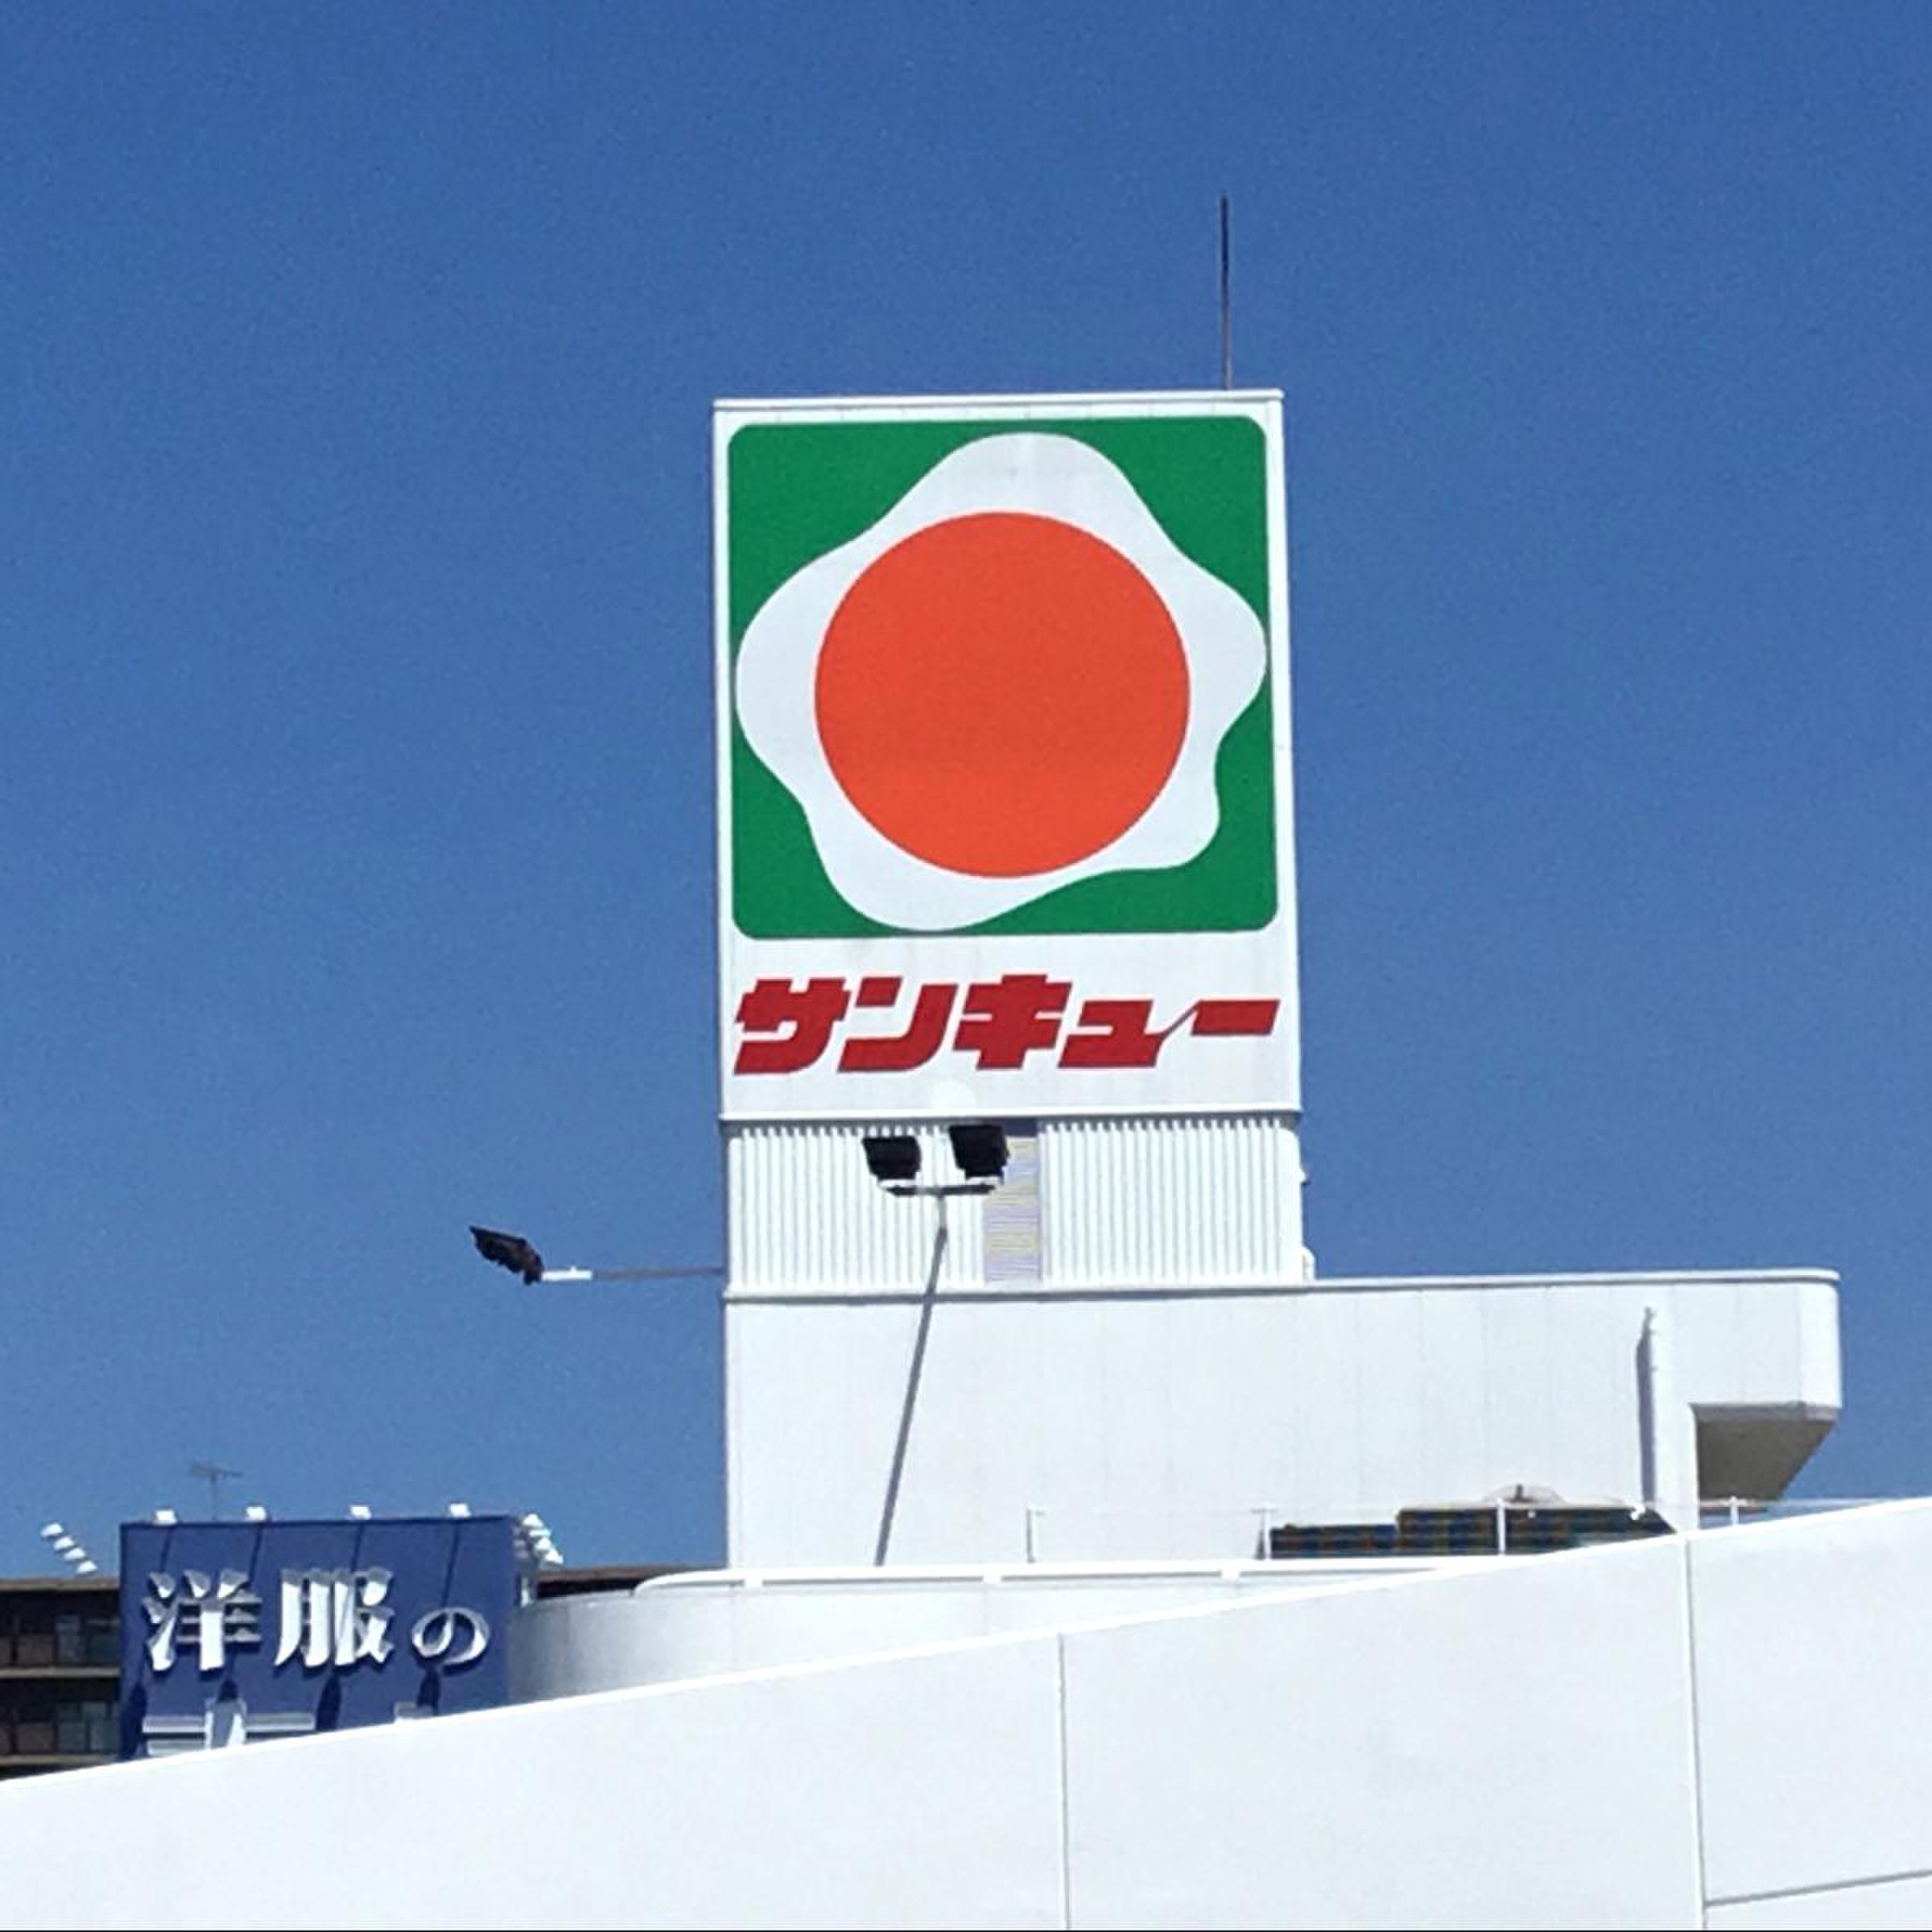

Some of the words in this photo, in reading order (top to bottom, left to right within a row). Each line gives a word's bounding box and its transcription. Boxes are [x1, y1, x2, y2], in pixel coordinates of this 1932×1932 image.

[733, 973, 1281, 1075] サンキュー
[142, 1569, 491, 1672] 洋服の
